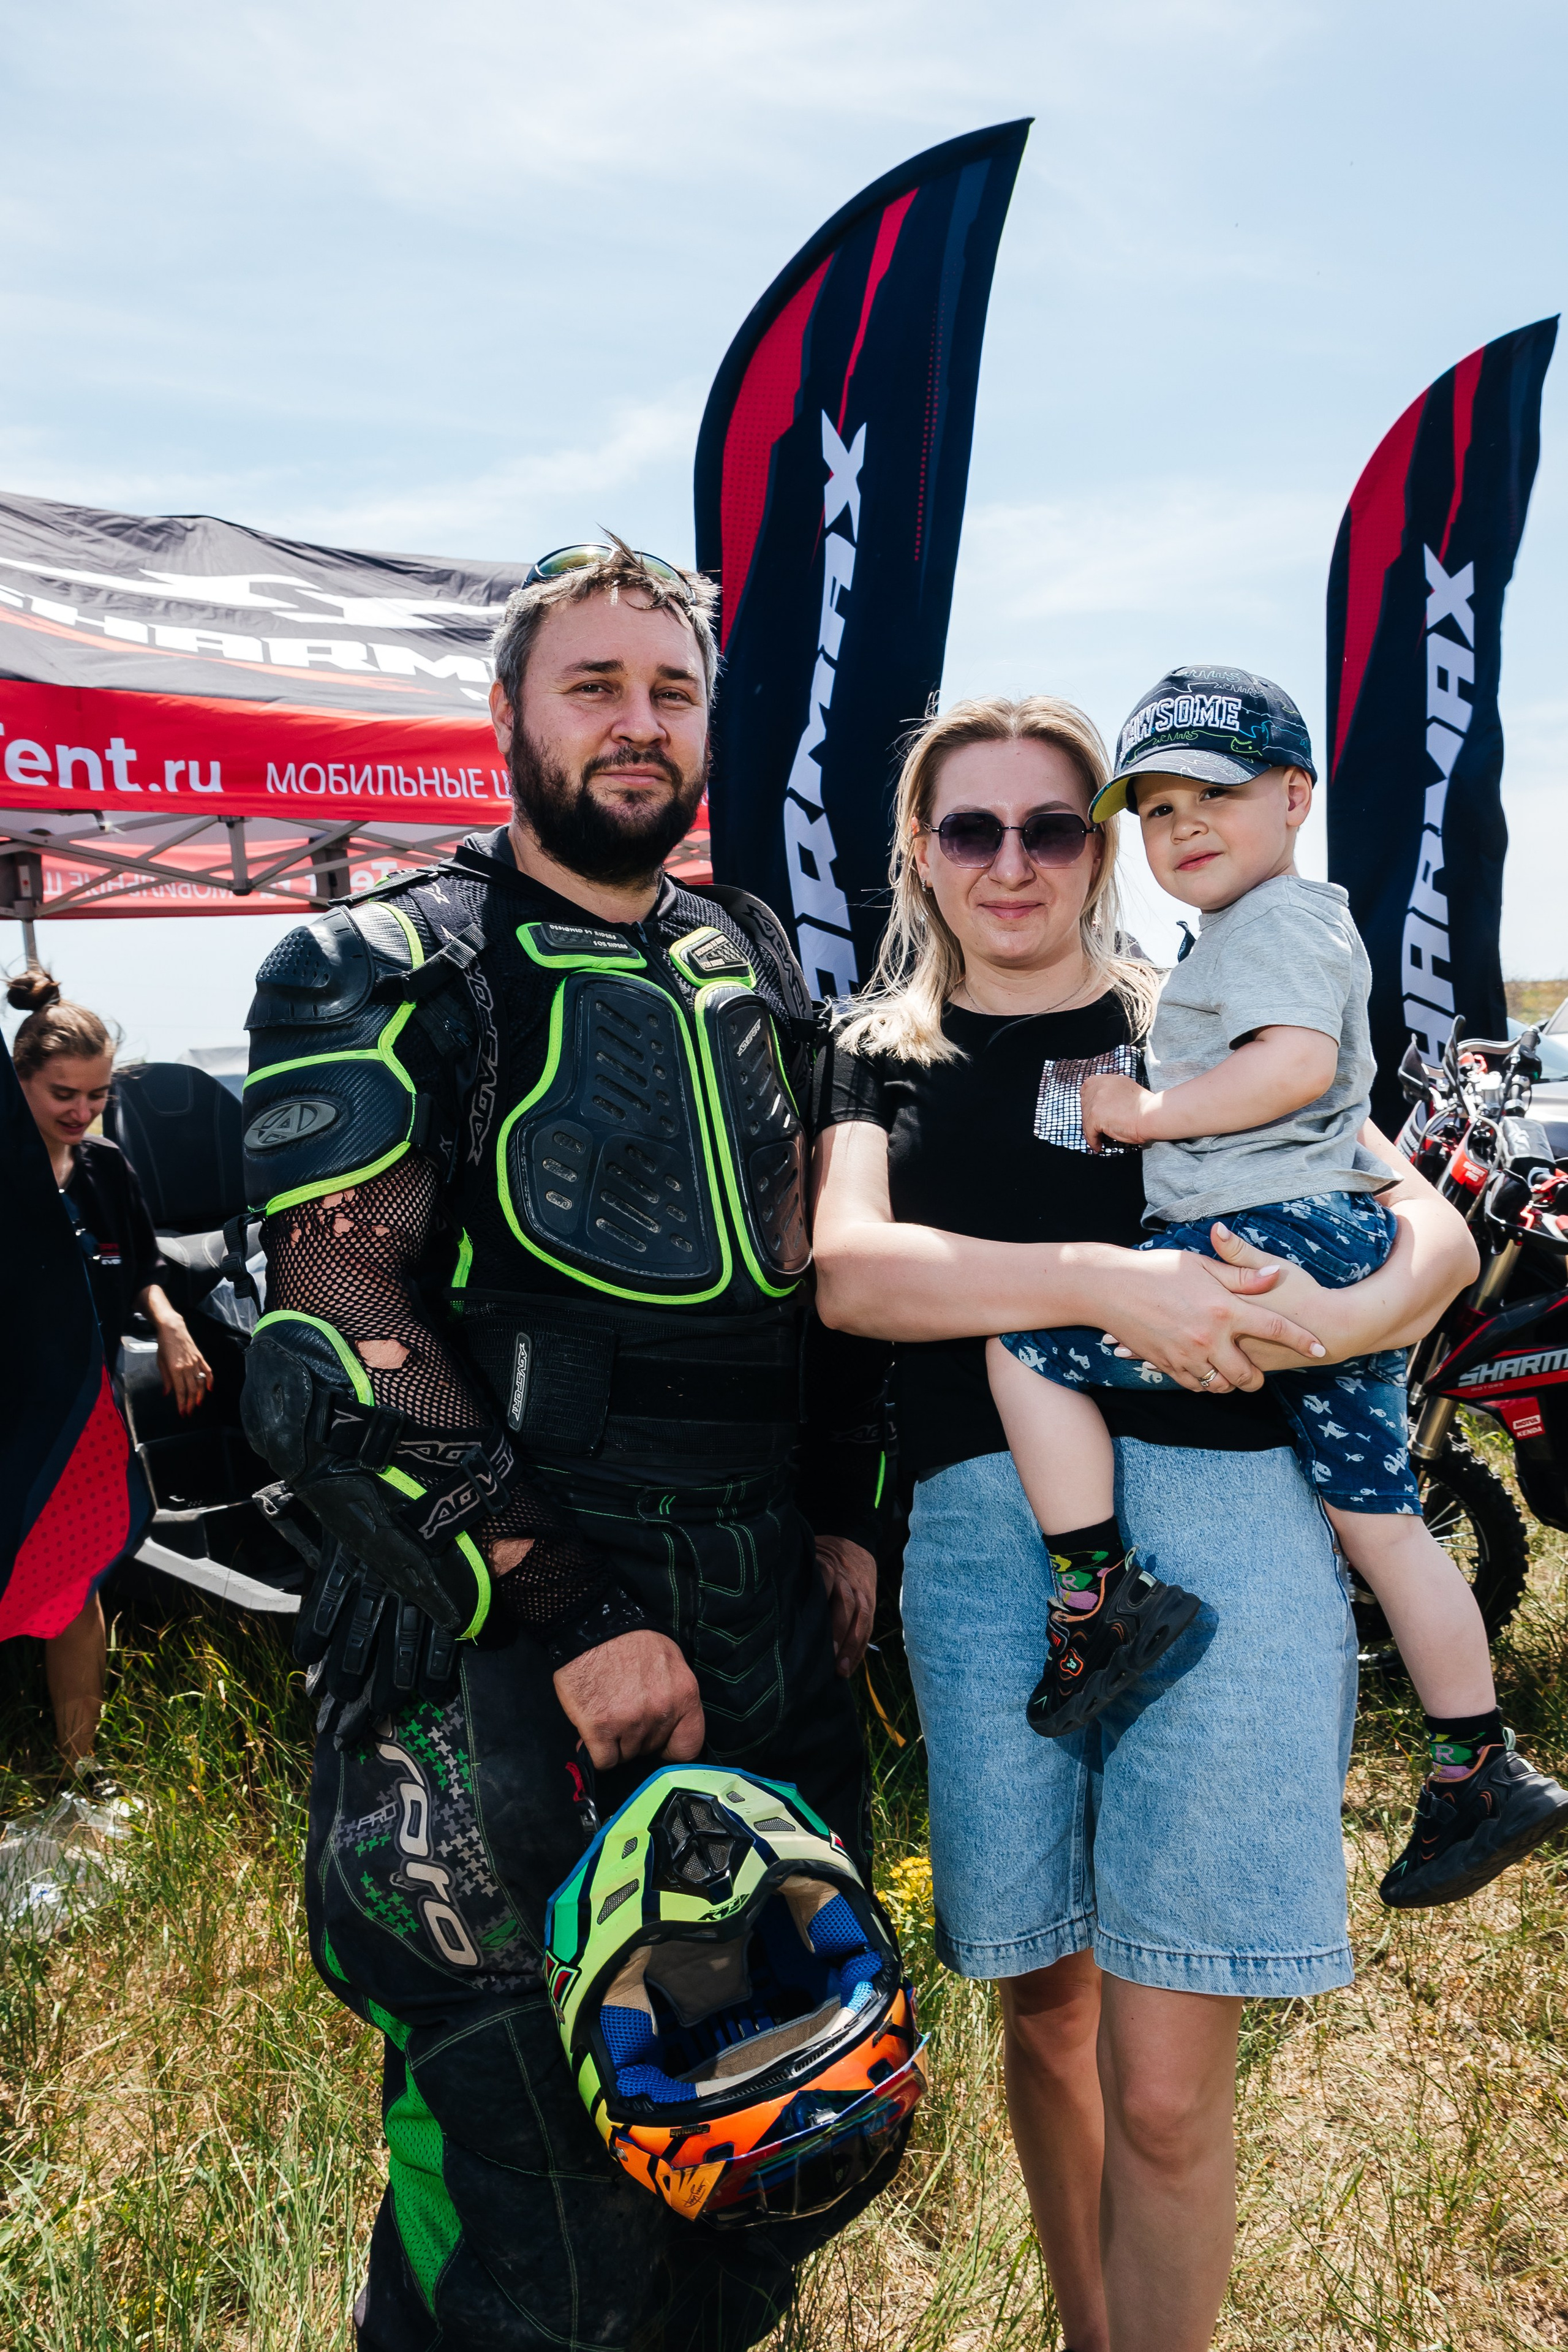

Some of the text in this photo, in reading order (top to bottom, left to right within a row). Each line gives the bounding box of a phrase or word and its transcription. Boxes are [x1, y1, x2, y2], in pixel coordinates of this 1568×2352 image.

[0, 582, 497, 684] HARM
[783, 409, 867, 1011] ARMAX
[0, 722, 224, 793] ent.ru
[266, 761, 489, 799] МОБИЛЬНЫЕ
[1401, 543, 1476, 1081] HARMAX
[549, 924, 583, 933] DESIGNED
[594, 930, 617, 940] RIDERS
[511, 1343, 527, 1422] AGVSPORT
[671, 2125, 709, 2137] Formula
